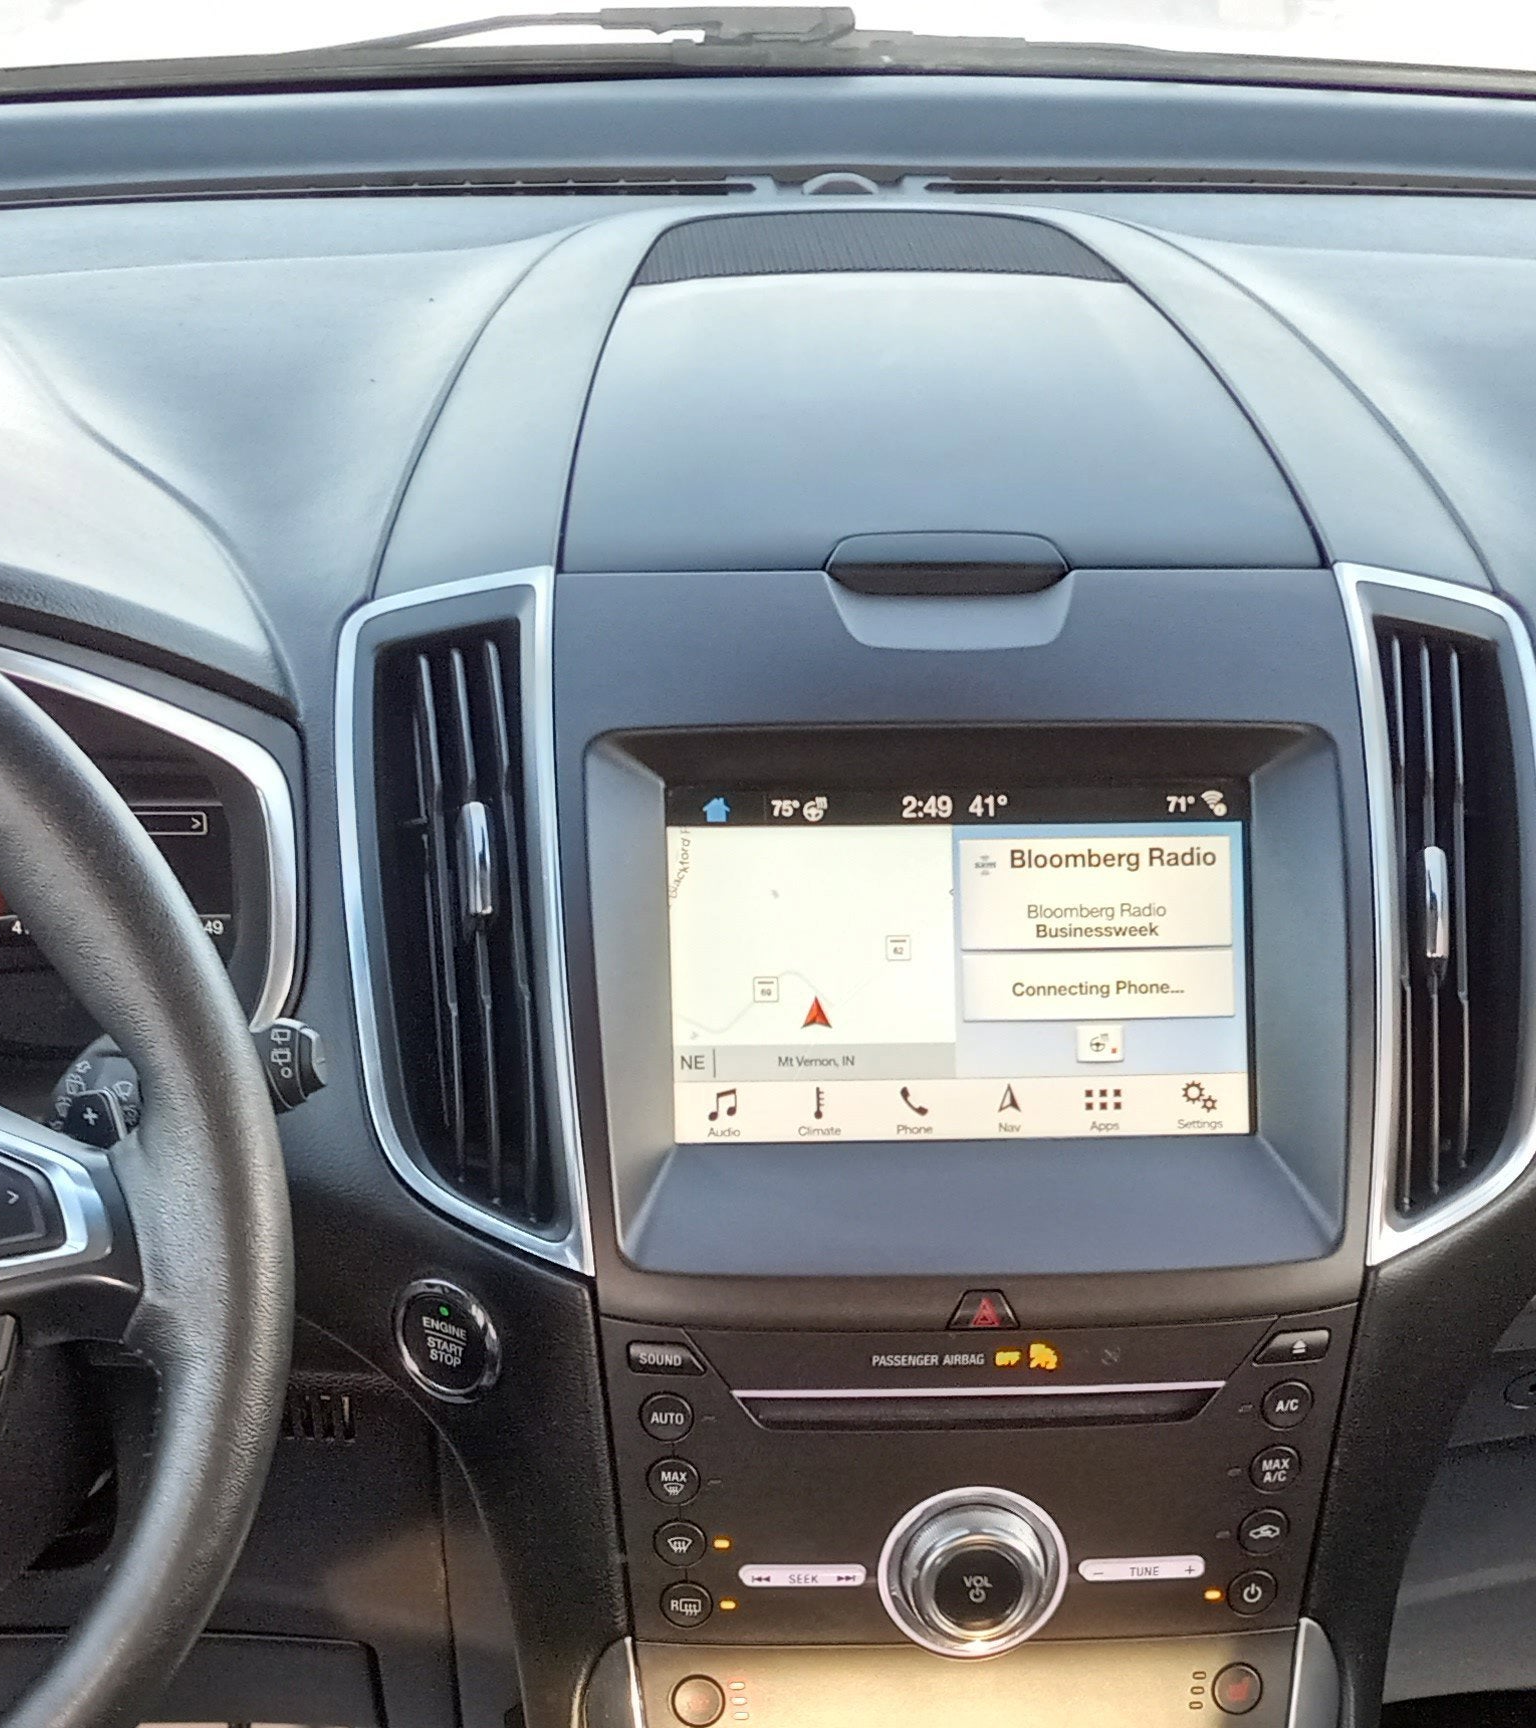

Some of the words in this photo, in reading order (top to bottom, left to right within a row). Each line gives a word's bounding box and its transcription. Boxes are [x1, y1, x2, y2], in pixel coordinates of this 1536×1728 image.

[902, 796, 953, 819] 2:49
[968, 794, 1008, 817] 41°
[1010, 848, 1140, 872] Bloomberg
[1148, 847, 1217, 868] Radio
[1027, 904, 1115, 921] Bloomberg
[1120, 902, 1167, 918] Radio
[1035, 922, 1160, 939] Businessweek
[1012, 981, 1111, 998] Connecting
[1115, 980, 1185, 996] Phone...
[680, 1056, 706, 1070] NE
[778, 1056, 793, 1068] Mt
[795, 1056, 839, 1068] Vernon,
[842, 1055, 855, 1067] IN
[798, 1125, 841, 1137] Climate
[896, 1124, 933, 1135] Phone
[998, 1122, 1021, 1133] Nav
[1090, 1121, 1120, 1133] Apps
[1177, 1118, 1224, 1131] Settings
[708, 1127, 741, 1138] Audio
[422, 1316, 467, 1341] ENGINE
[427, 1336, 463, 1358] START
[429, 1350, 462, 1368] STOP
[639, 1353, 682, 1366] SOUND
[872, 1354, 939, 1367] PASSENGER
[942, 1353, 985, 1366] AIRBAG
[1275, 1398, 1299, 1412] A/C
[650, 1411, 684, 1425] AUTO
[1262, 1458, 1290, 1471] MAX
[661, 1471, 687, 1482] MAX
[1263, 1470, 1287, 1483] A/C
[1129, 1566, 1160, 1577] TUNE
[788, 1574, 819, 1585] SEEK
[963, 1576, 993, 1588] VOL
